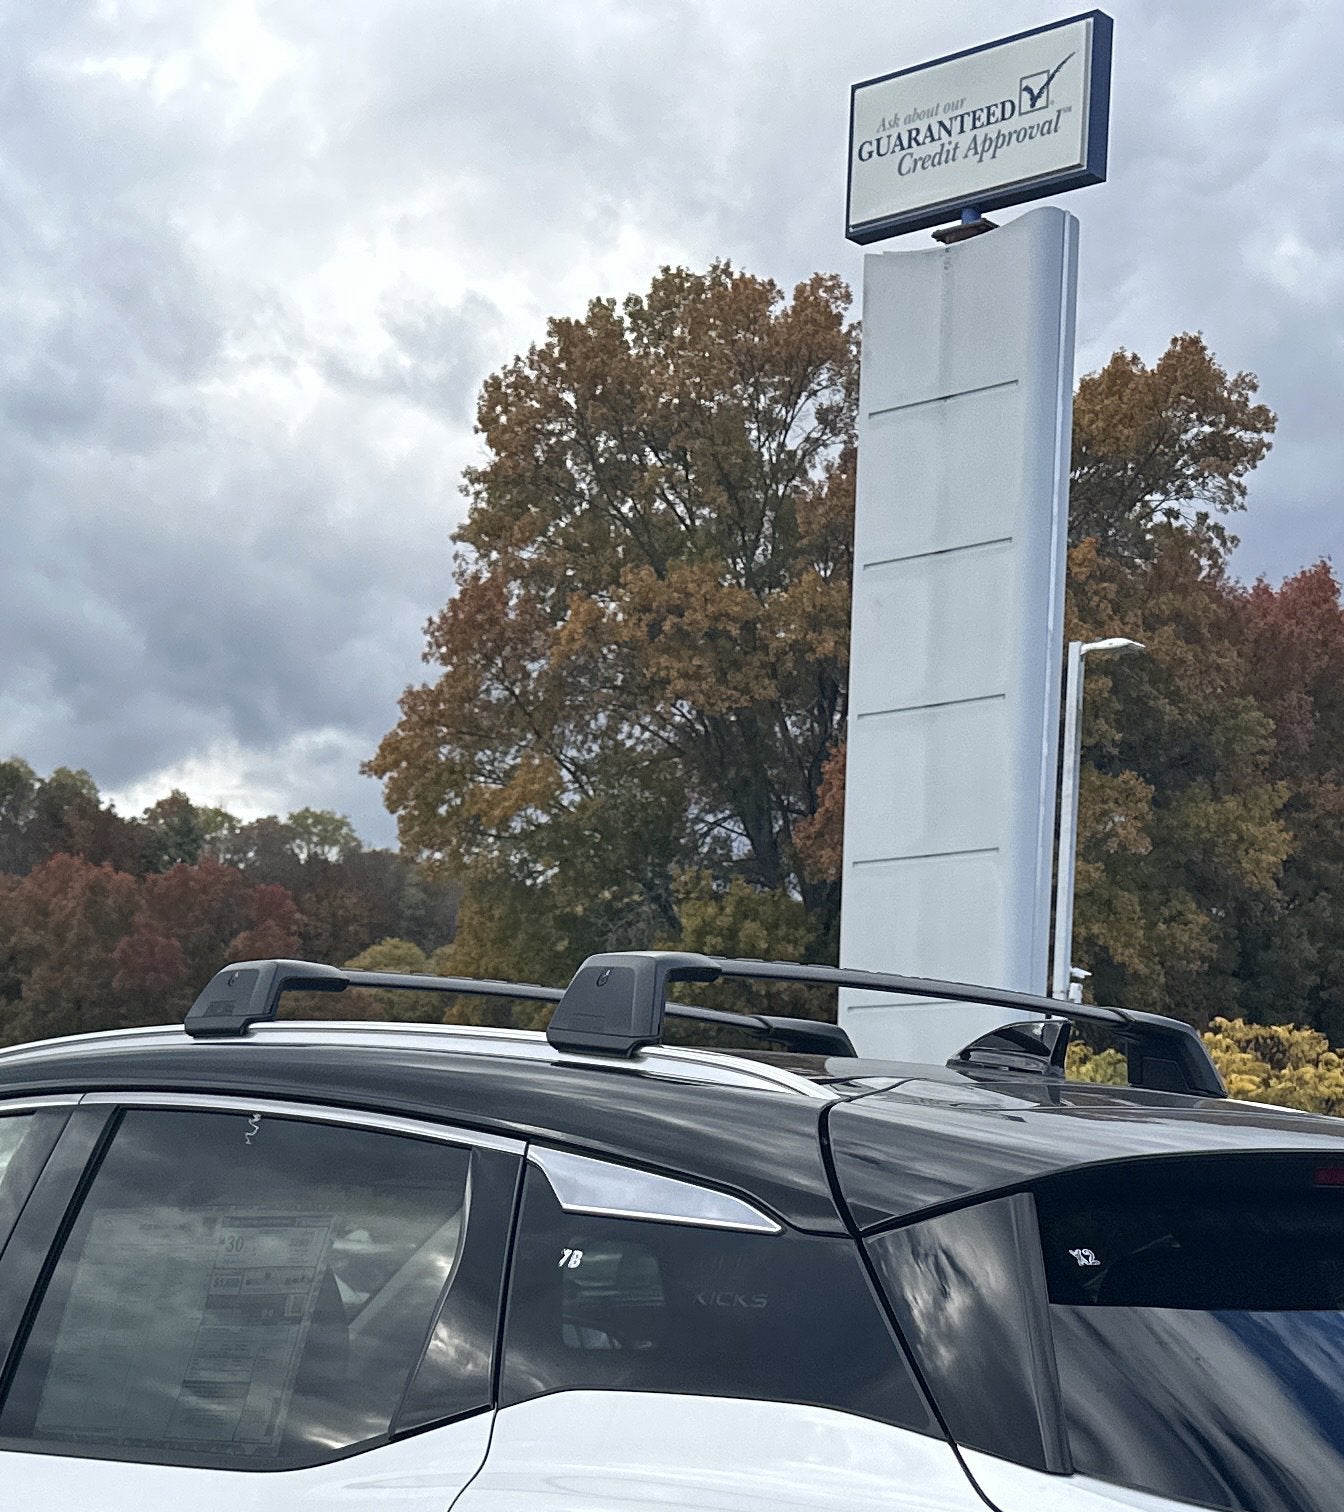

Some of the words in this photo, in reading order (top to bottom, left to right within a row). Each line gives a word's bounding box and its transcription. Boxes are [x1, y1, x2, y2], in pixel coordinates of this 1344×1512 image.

[857, 100, 1016, 162] GUARANTEED
[876, 113, 901, 134] Ask
[903, 107, 941, 126] about
[943, 97, 967, 114] our
[897, 140, 961, 176] Credit
[962, 108, 1063, 163] Approval
